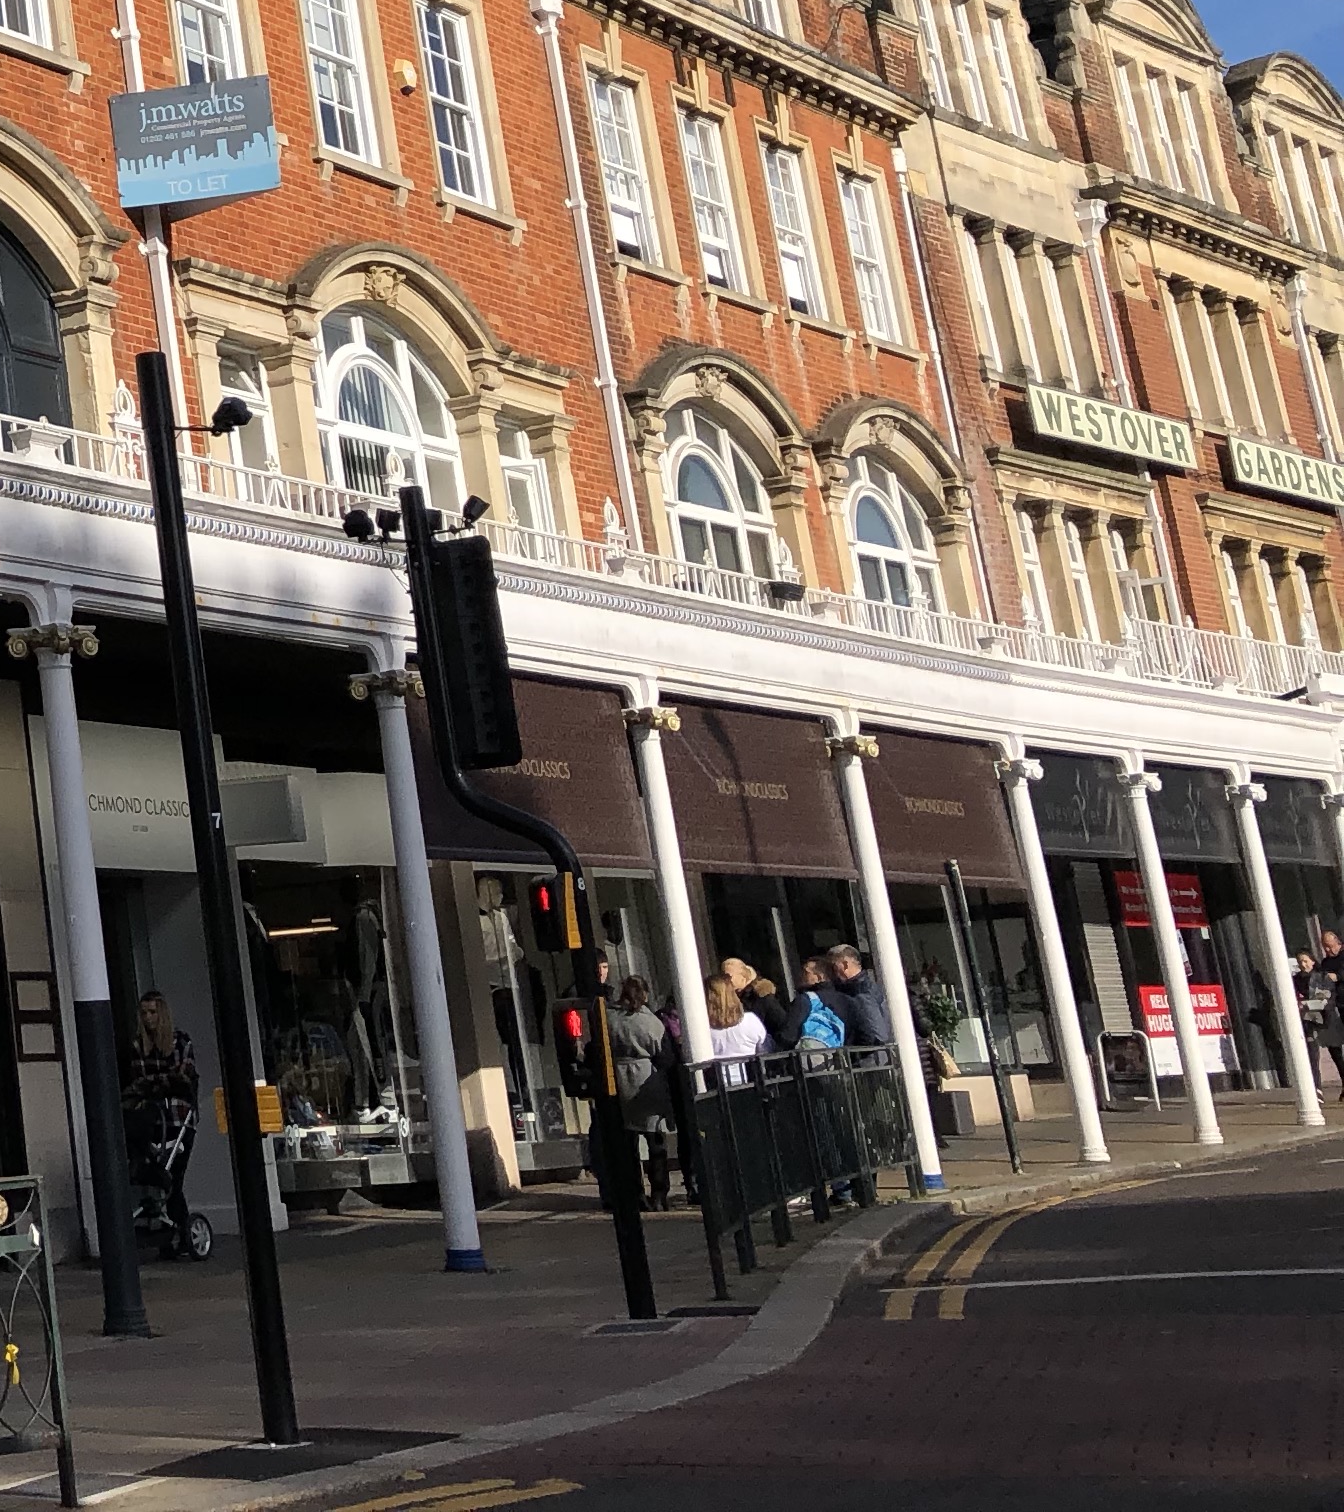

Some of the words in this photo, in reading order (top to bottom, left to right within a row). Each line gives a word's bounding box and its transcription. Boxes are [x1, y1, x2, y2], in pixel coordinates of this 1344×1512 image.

[193, 116, 221, 127] Property
[167, 180, 192, 195] TO
[197, 175, 227, 191] LET
[1036, 390, 1191, 463] WESTOVER
[1237, 443, 1344, 502] GARDENS
[88, 794, 142, 814] CHMOND
[144, 798, 190, 818] CLASSIC
[211, 812, 221, 829] 7
[577, 877, 586, 891] 8
[1198, 993, 1219, 1008] SALE
